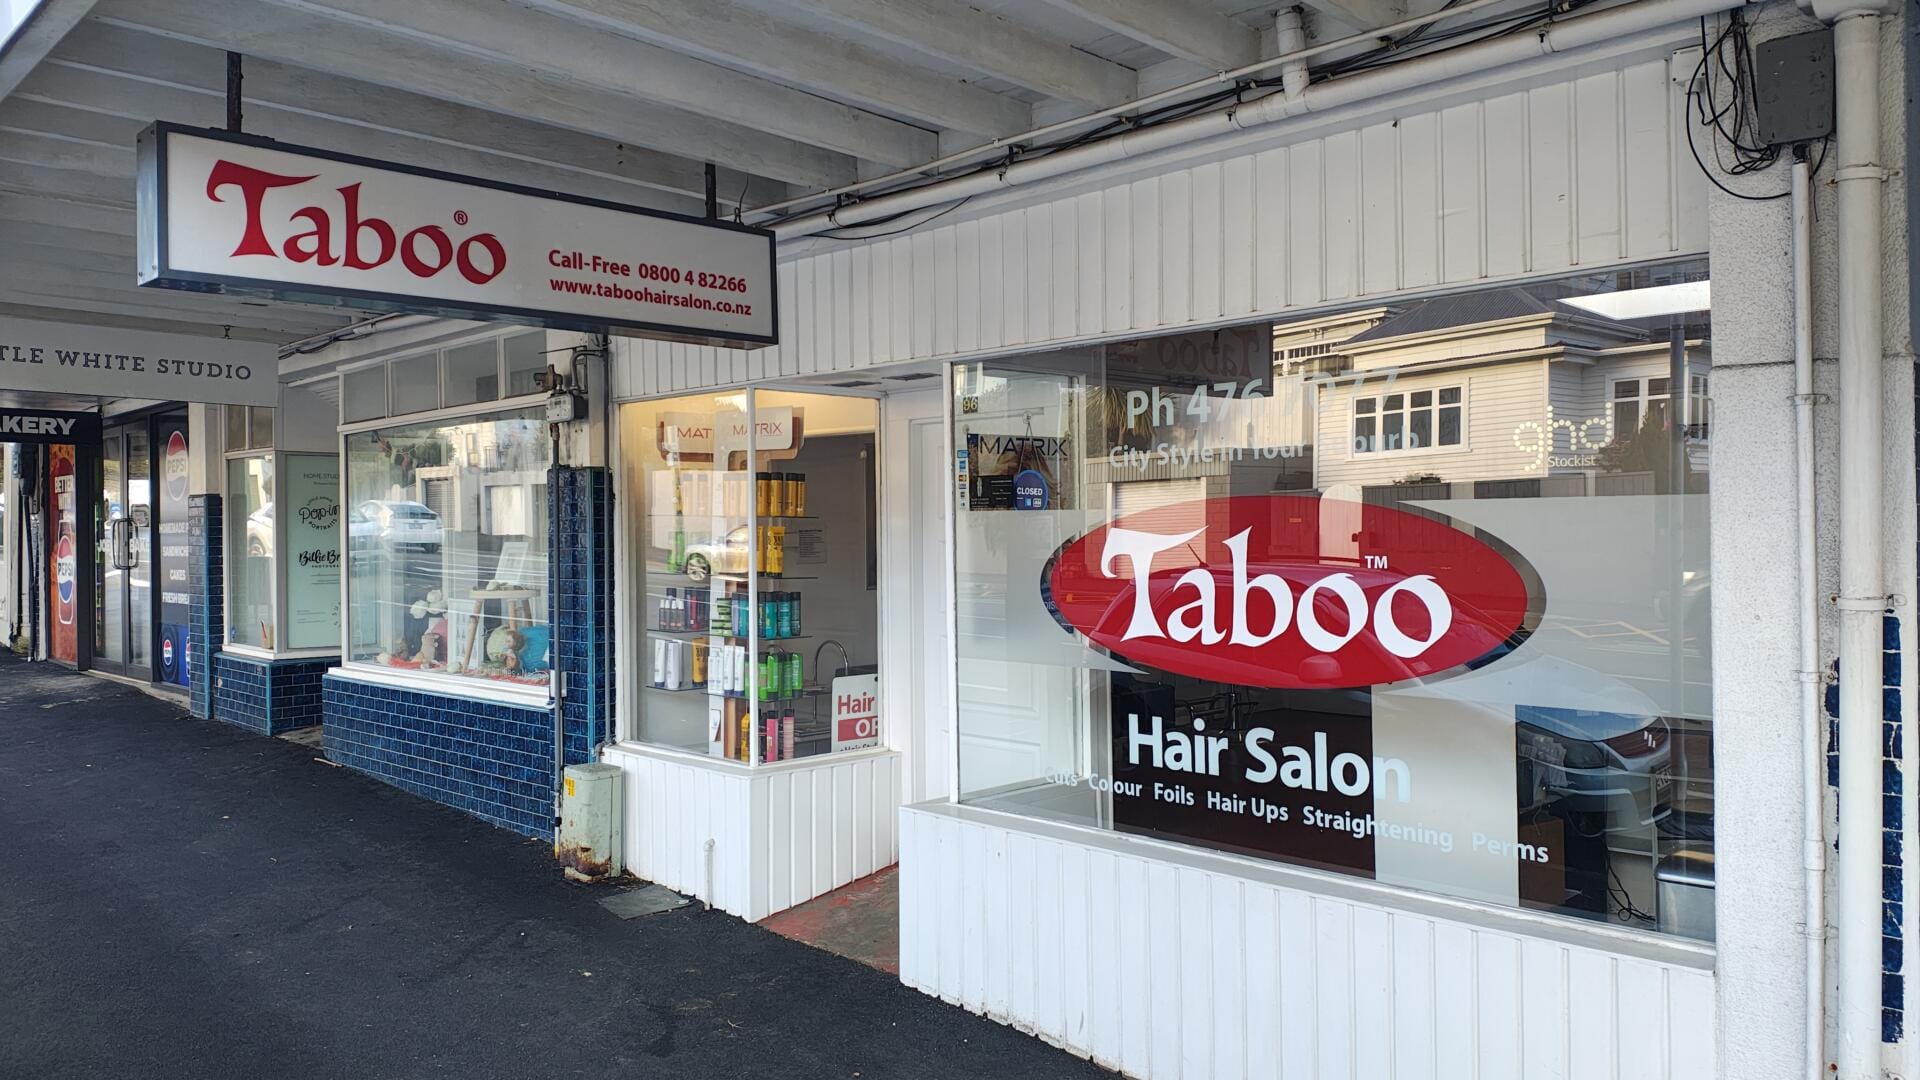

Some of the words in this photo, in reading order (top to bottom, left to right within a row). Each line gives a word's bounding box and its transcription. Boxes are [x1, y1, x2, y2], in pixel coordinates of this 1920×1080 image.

[206, 159, 507, 285] Taboo
[548, 249, 631, 277] Call-Free
[638, 262, 681, 284] 0800
[684, 270, 694, 286] 4
[698, 271, 747, 293] 82266
[549, 278, 752, 316] www.taboohairsalon.co.nz
[55, 349, 145, 372] WHITE
[157, 358, 251, 381] STUDIO
[962, 398, 978, 412] 96
[1126, 386, 1175, 429] Ph
[1186, 378, 1265, 423] 476
[0, 415, 77, 436] KERY
[1512, 401, 1613, 472] ghd
[979, 436, 1068, 457] MATRIX
[1108, 443, 1150, 473] City
[1157, 440, 1214, 470] Style
[1547, 454, 1597, 467] Stockist
[1016, 486, 1043, 496] CLOSED
[1100, 524, 1453, 658] Taboo
[837, 691, 875, 715] Hair
[1127, 713, 1229, 776] Hair
[1244, 727, 1411, 803] Salon
[1088, 772, 1143, 797] Colour
[1153, 782, 1195, 806] Foils
[1207, 790, 1246, 815] Hair
[1251, 797, 1289, 823] Ups
[1302, 805, 1454, 852] Straightening
[1471, 832, 1549, 864] Perms
